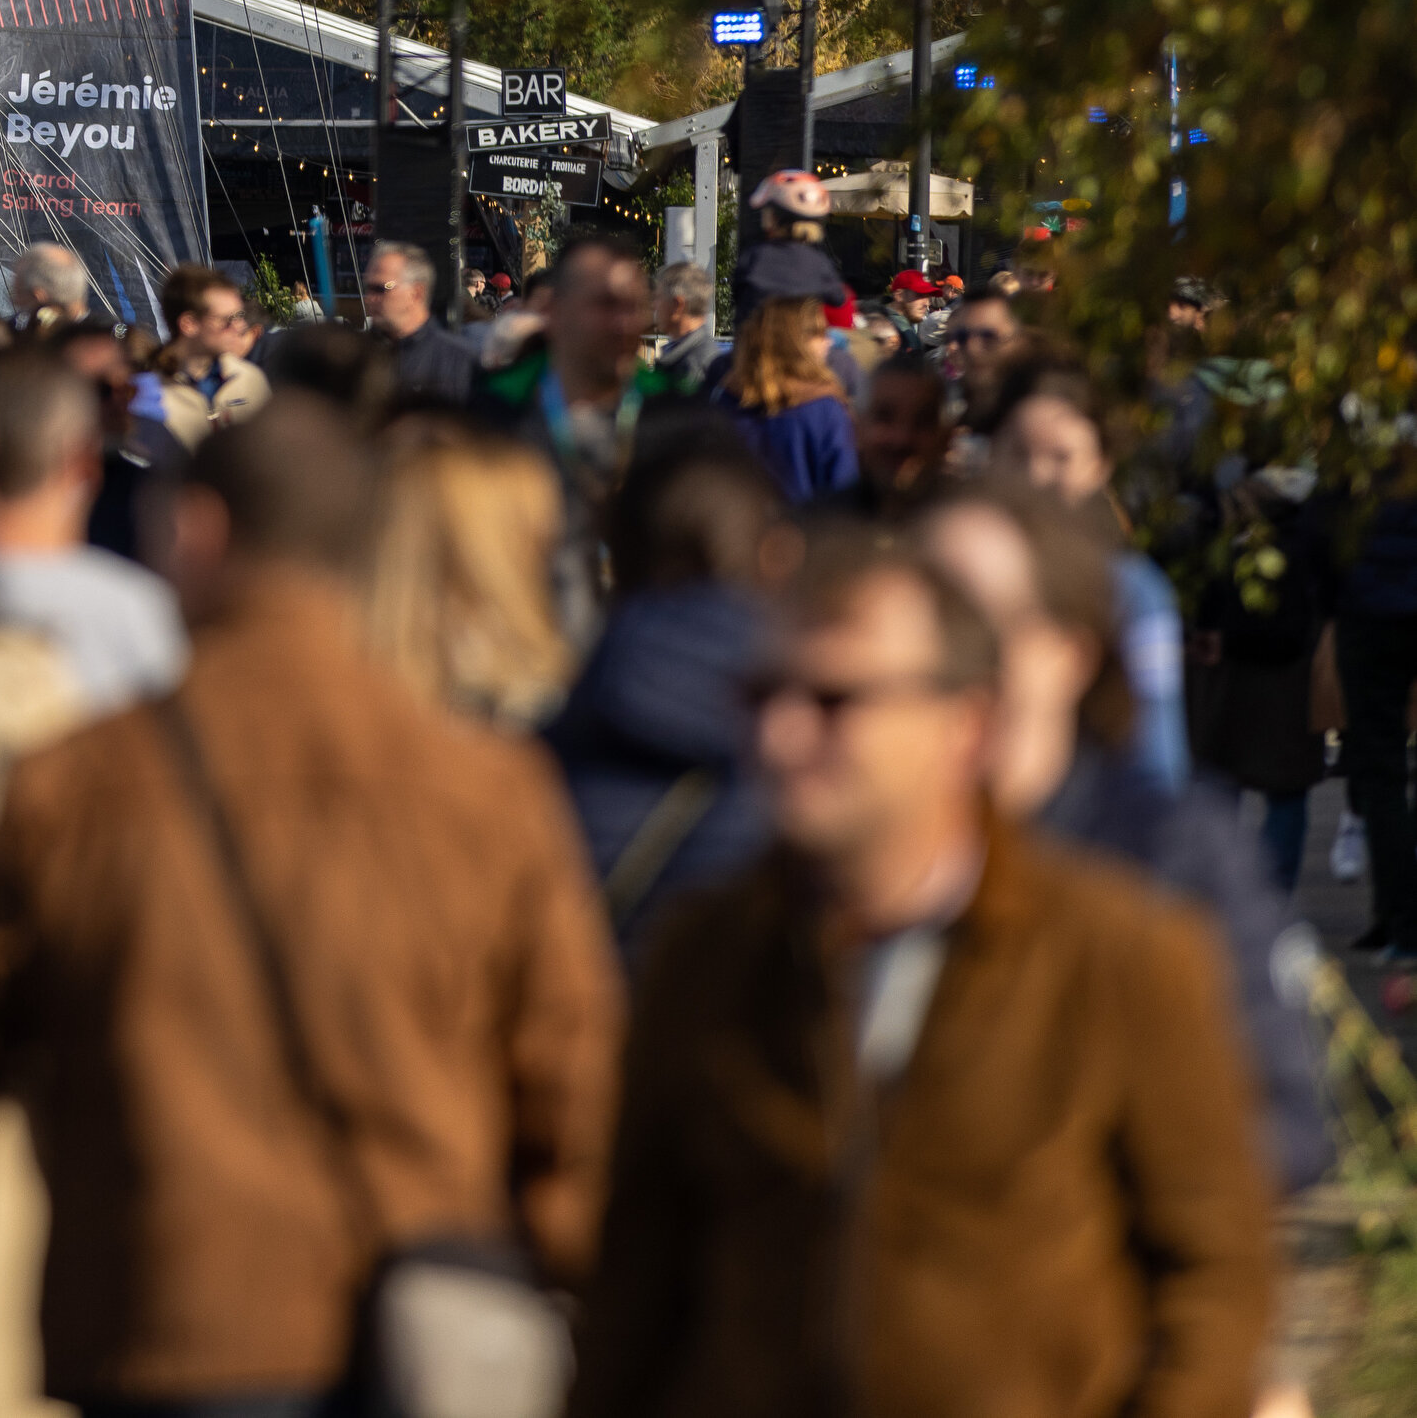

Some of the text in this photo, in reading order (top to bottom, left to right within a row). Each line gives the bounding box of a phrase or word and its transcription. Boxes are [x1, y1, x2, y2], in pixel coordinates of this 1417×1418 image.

[8, 69, 177, 111] Jérémie
[505, 74, 563, 105] BAR
[7, 112, 135, 158] Beyou
[478, 119, 598, 147] BAKERY
[489, 155, 539, 170] CHARCUTERIE
[551, 160, 587, 175] FROMAGE
[3, 168, 76, 190] Charal
[503, 176, 563, 198] BORDIR
[2, 193, 141, 218] Sailing Team
